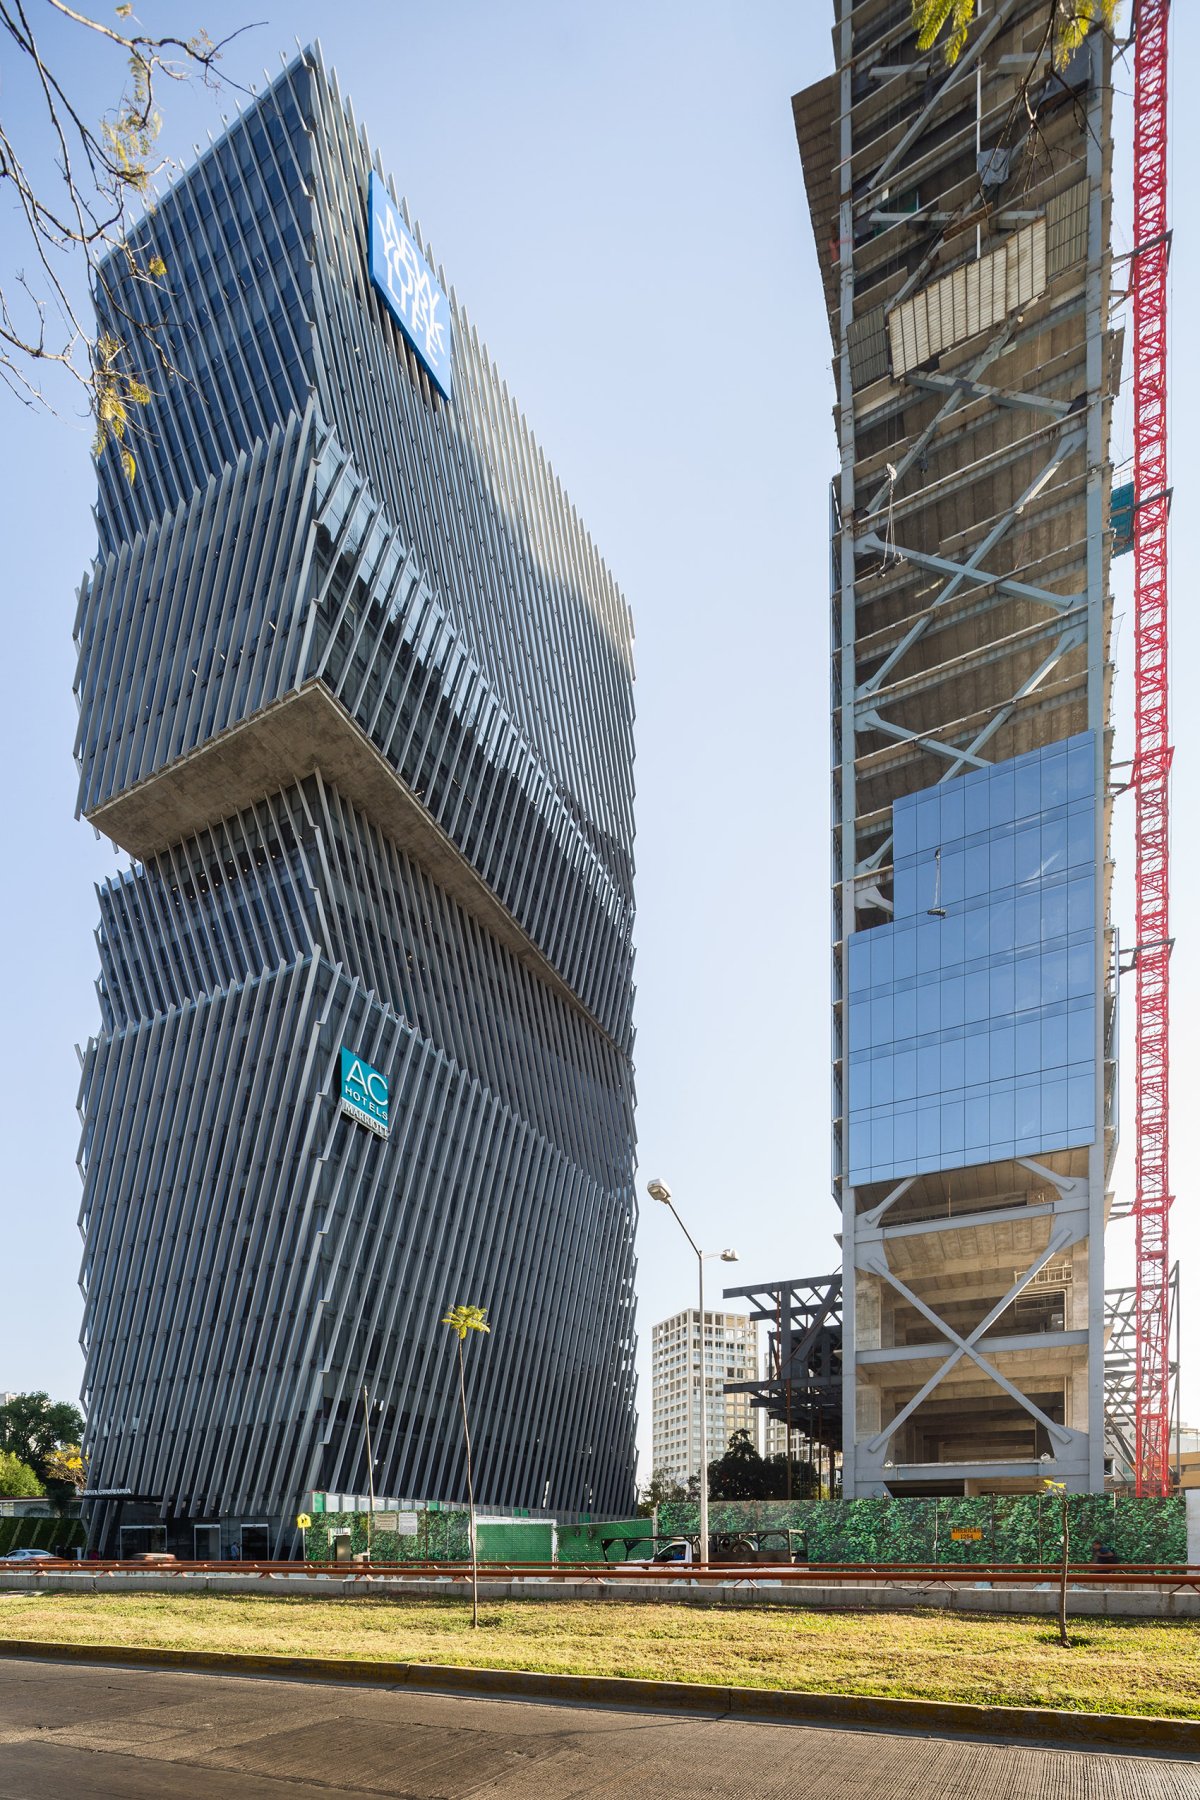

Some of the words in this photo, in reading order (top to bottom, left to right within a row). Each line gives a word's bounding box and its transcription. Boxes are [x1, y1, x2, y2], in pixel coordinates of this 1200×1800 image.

[375, 211, 445, 355] YORK
[385, 202, 440, 309] NEW
[386, 260, 438, 367] LIFE
[344, 1085, 388, 1121] HOTELS
[344, 1104, 388, 1137] MARRIOTT
[346, 1059, 388, 1106] AC
